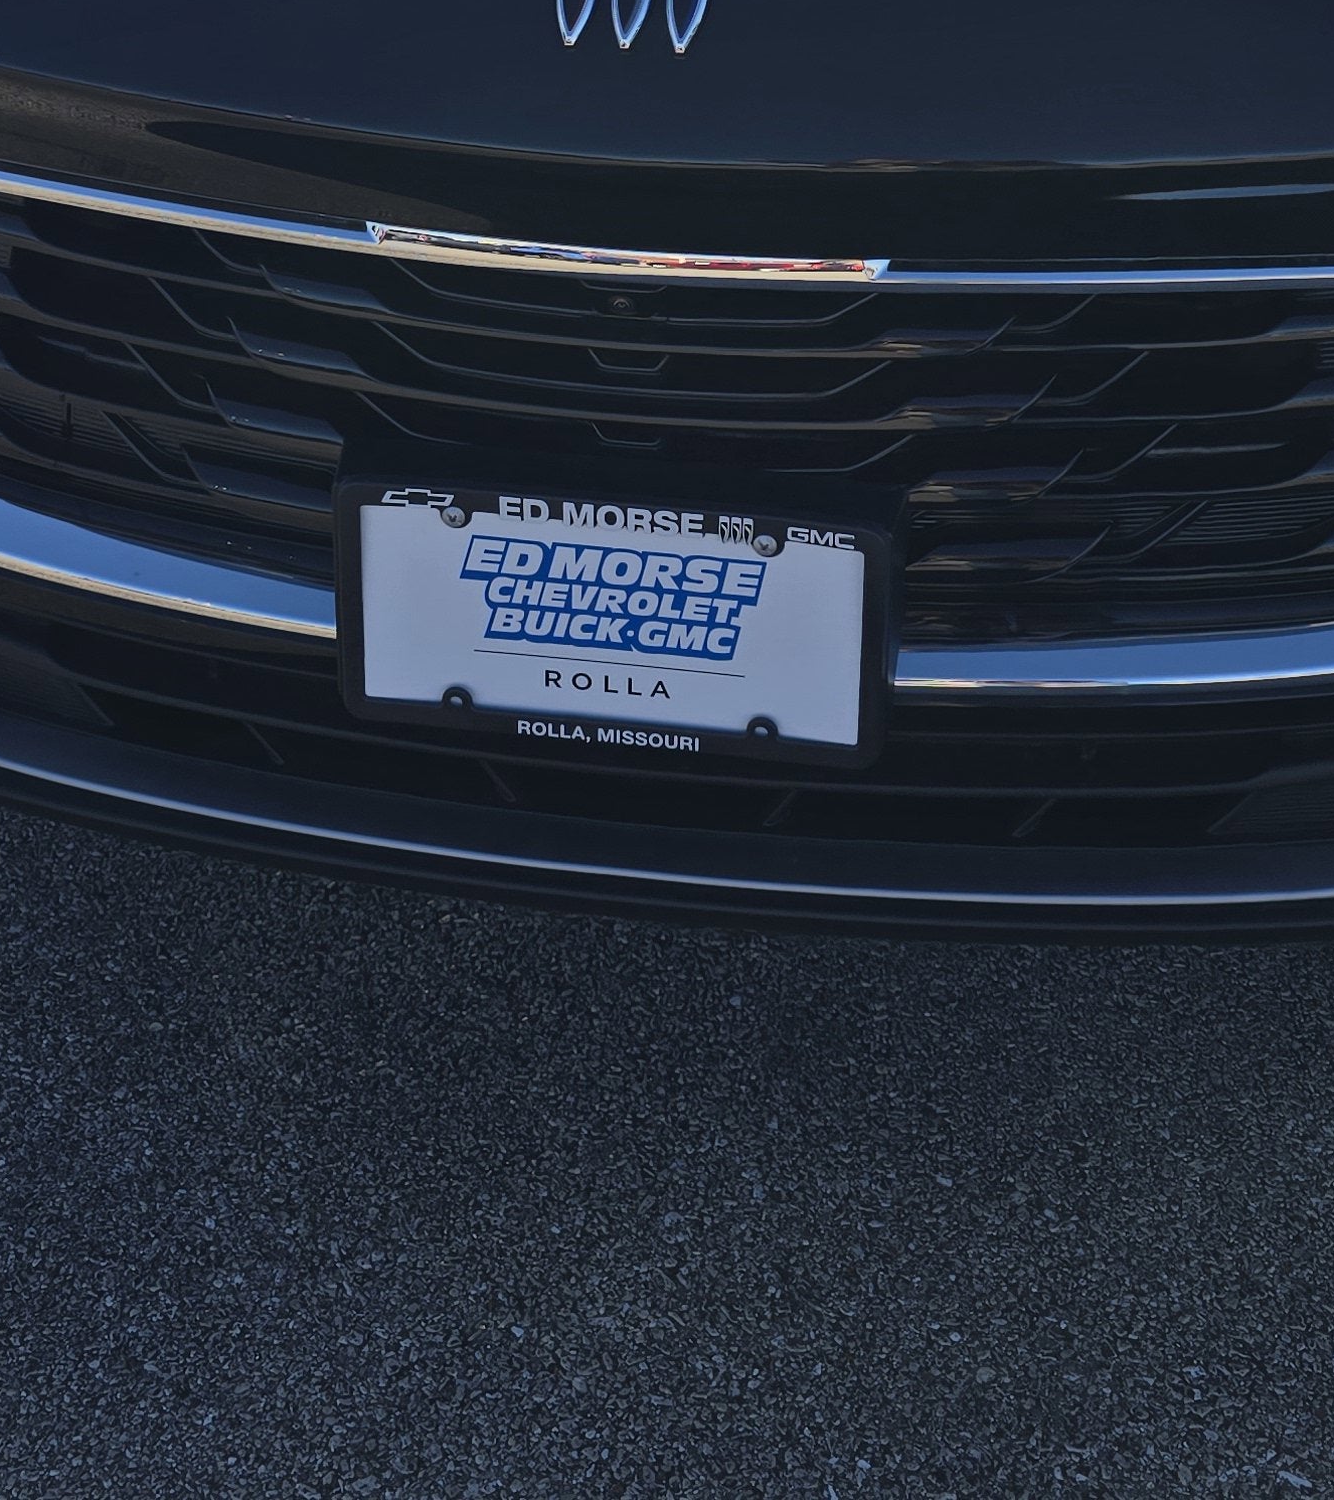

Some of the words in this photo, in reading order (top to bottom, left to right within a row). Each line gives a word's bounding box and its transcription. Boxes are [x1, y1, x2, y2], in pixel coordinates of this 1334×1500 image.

[498, 495, 550, 523] ED
[563, 501, 704, 538] MORSE
[787, 526, 855, 549] GMC
[465, 537, 543, 576] ED
[547, 546, 764, 598] MORSE
[543, 669, 670, 699] ROLLA
[517, 720, 591, 744] ROLLA,
[597, 728, 700, 752] MISSOURI
